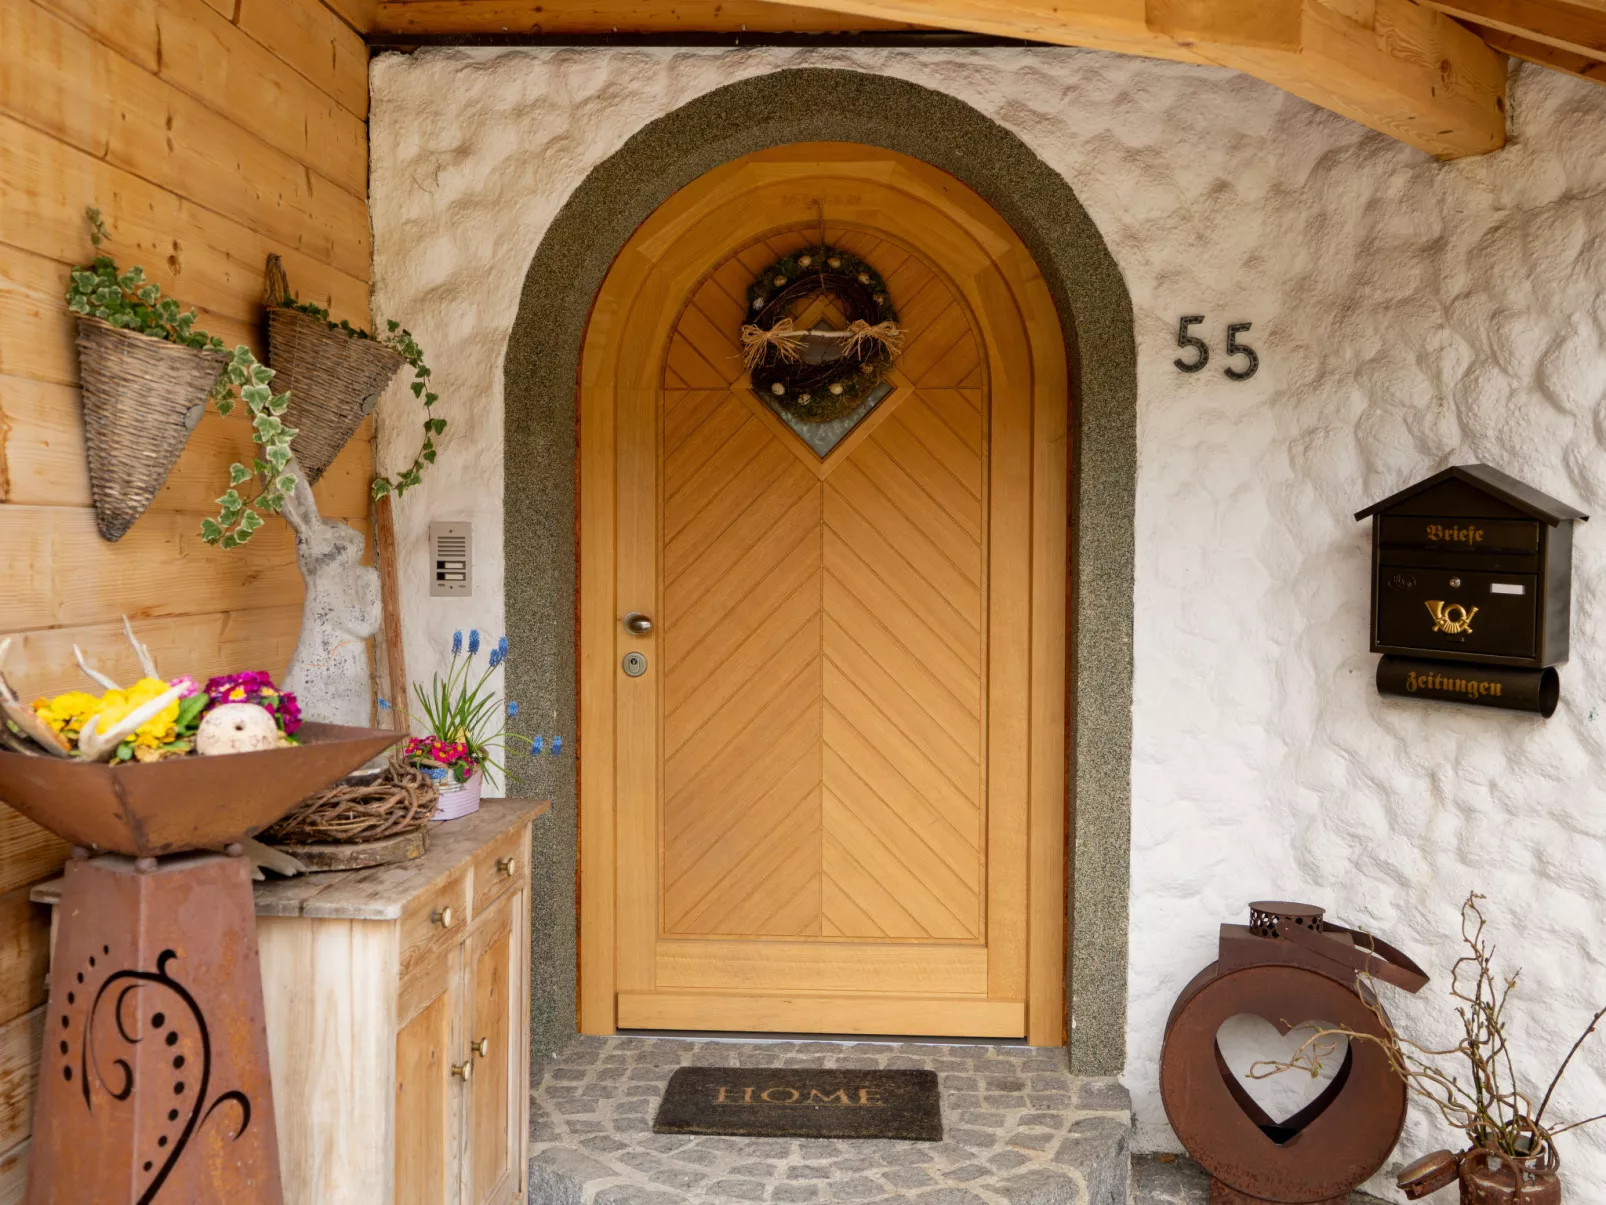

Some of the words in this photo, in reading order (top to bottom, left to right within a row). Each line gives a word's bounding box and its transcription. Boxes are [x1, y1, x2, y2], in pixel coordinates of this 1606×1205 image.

[1173, 315, 1260, 382] 55
[1426, 524, 1484, 546] Briefe
[1406, 671, 1502, 699] Zeitungen
[714, 1087, 885, 1106] HOME
